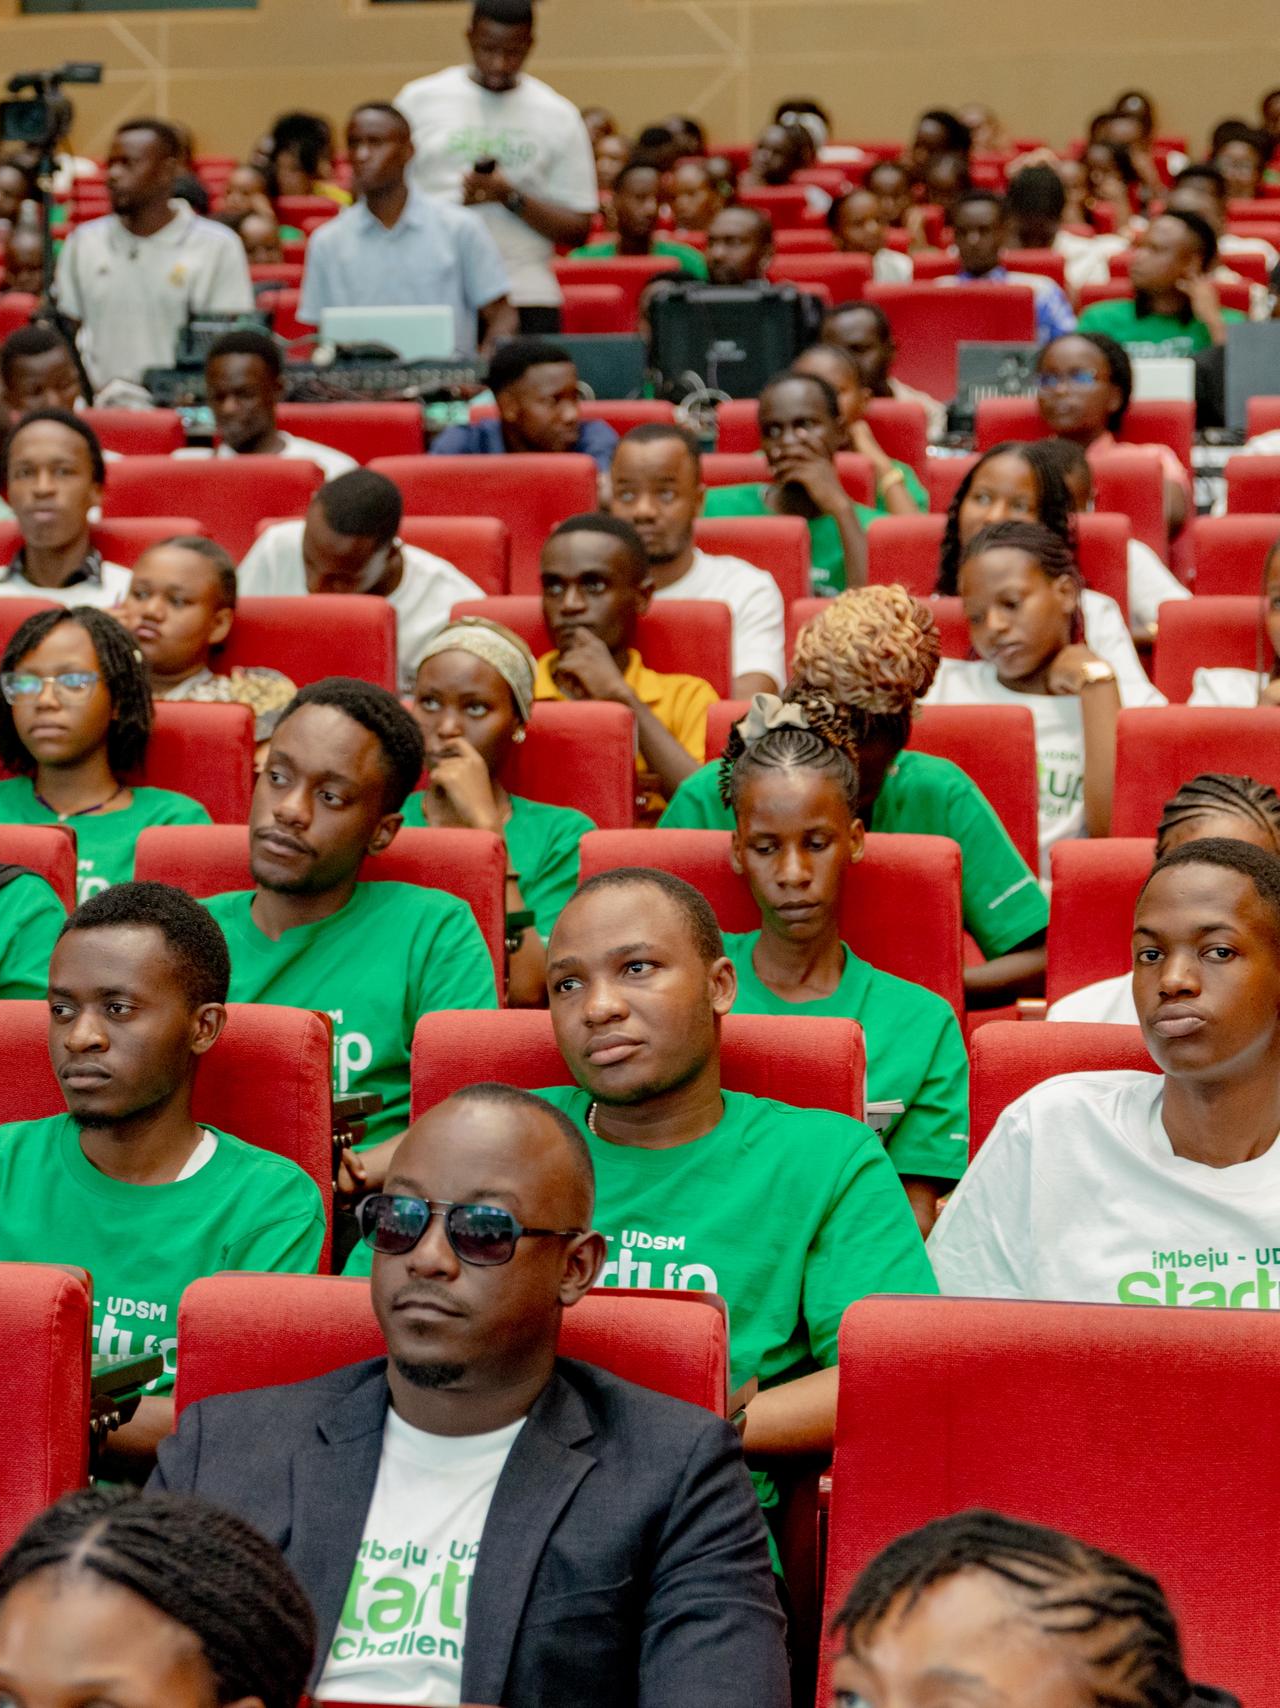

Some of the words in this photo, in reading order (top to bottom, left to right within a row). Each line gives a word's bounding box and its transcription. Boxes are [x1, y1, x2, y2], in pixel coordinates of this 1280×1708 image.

[621, 1230, 686, 1251] UDSM
[1152, 1248, 1228, 1273] iMbeju
[1117, 1268, 1280, 1309] Start
[106, 1296, 167, 1322] UDSM
[332, 1631, 465, 1661] Challen
